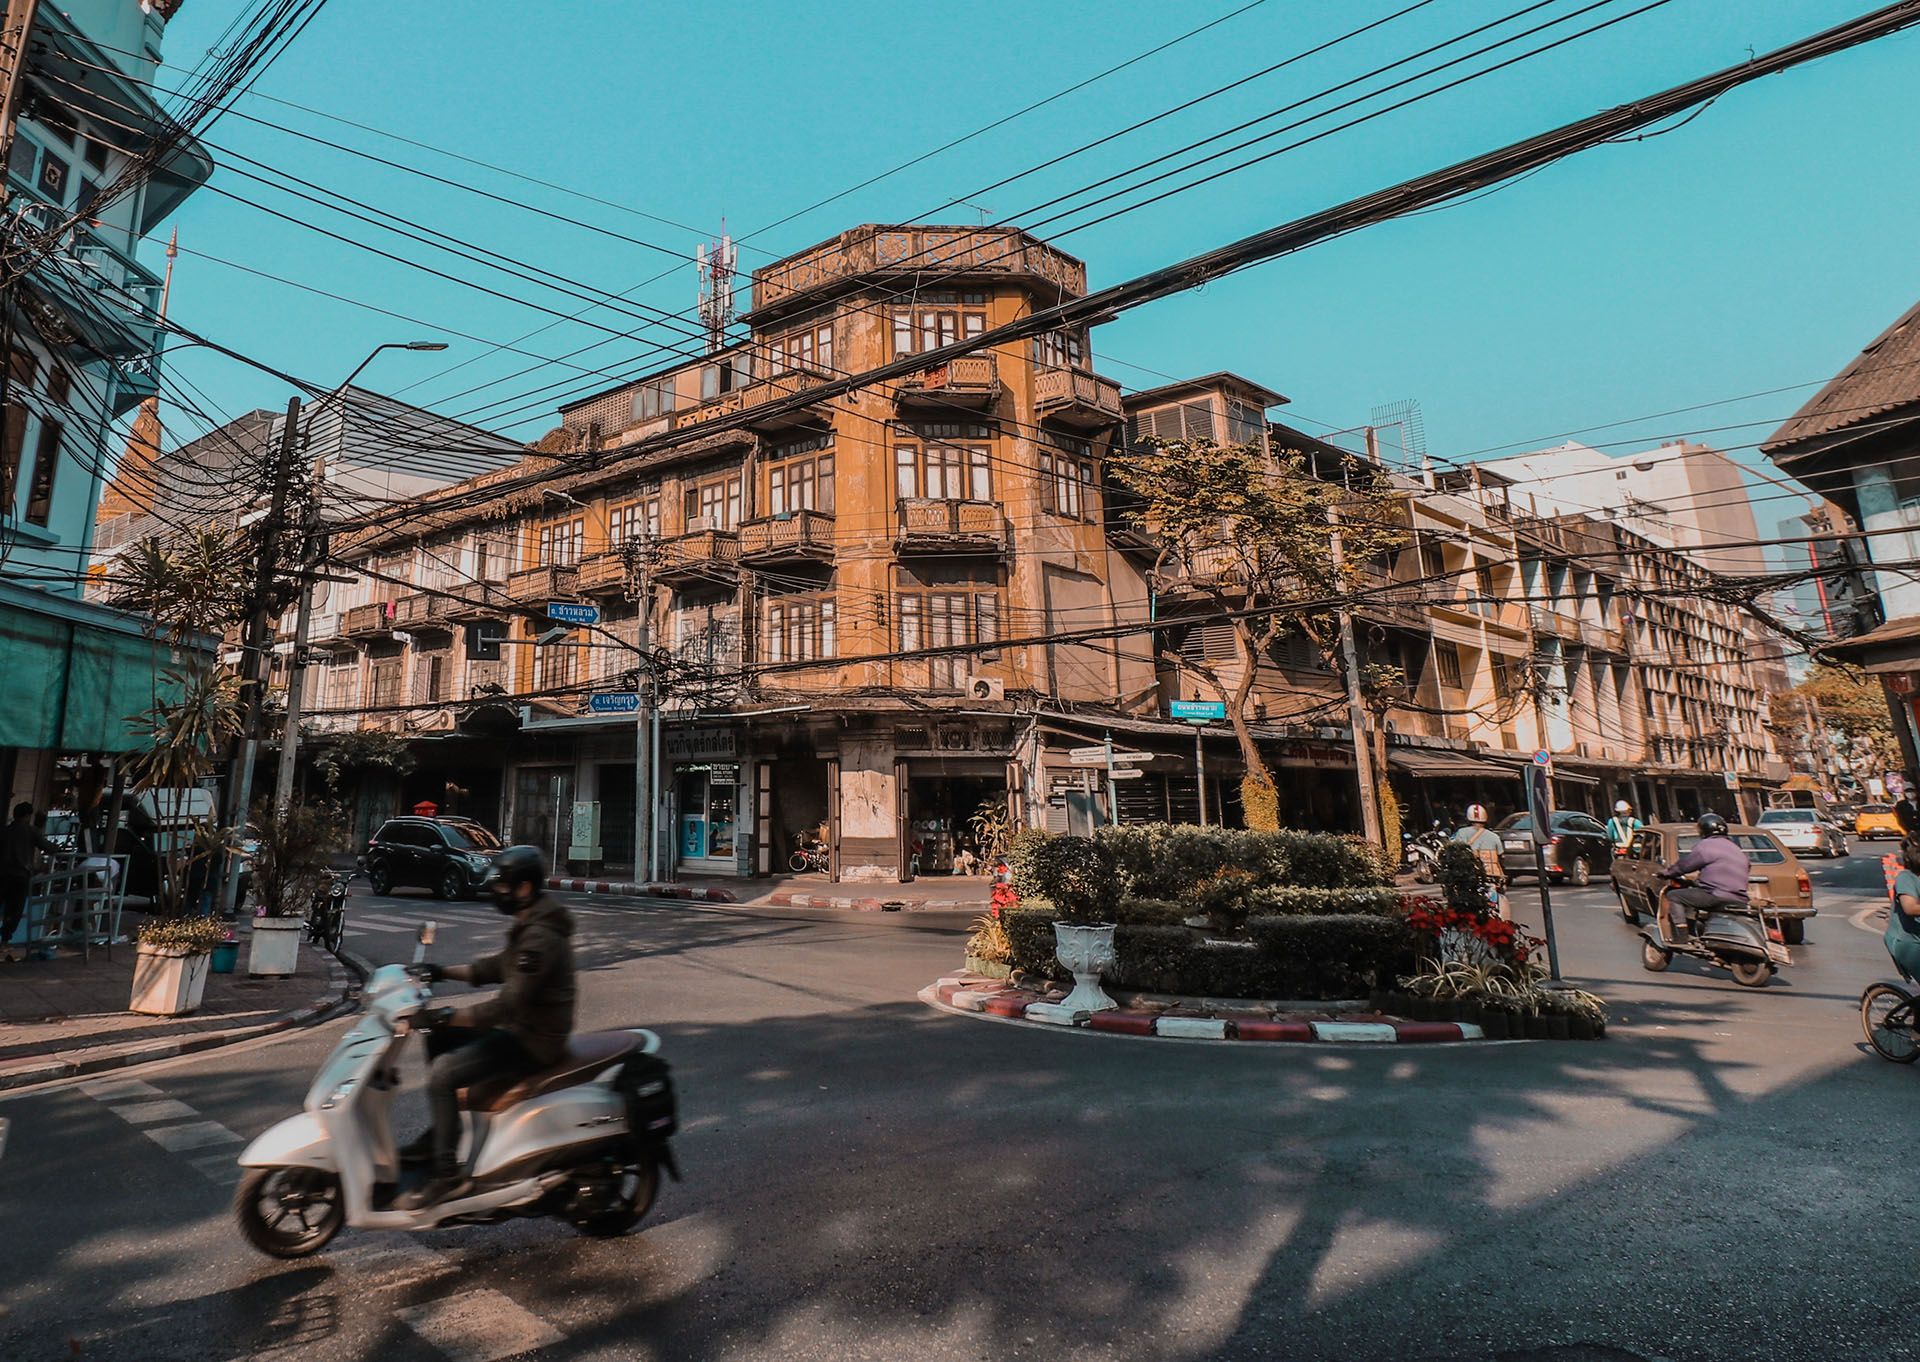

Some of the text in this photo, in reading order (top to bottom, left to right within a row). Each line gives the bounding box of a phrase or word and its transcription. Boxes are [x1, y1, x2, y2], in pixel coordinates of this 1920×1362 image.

[559, 605, 593, 617] ข้าวหลาม
[602, 695, 634, 706] เจริญกรุง
